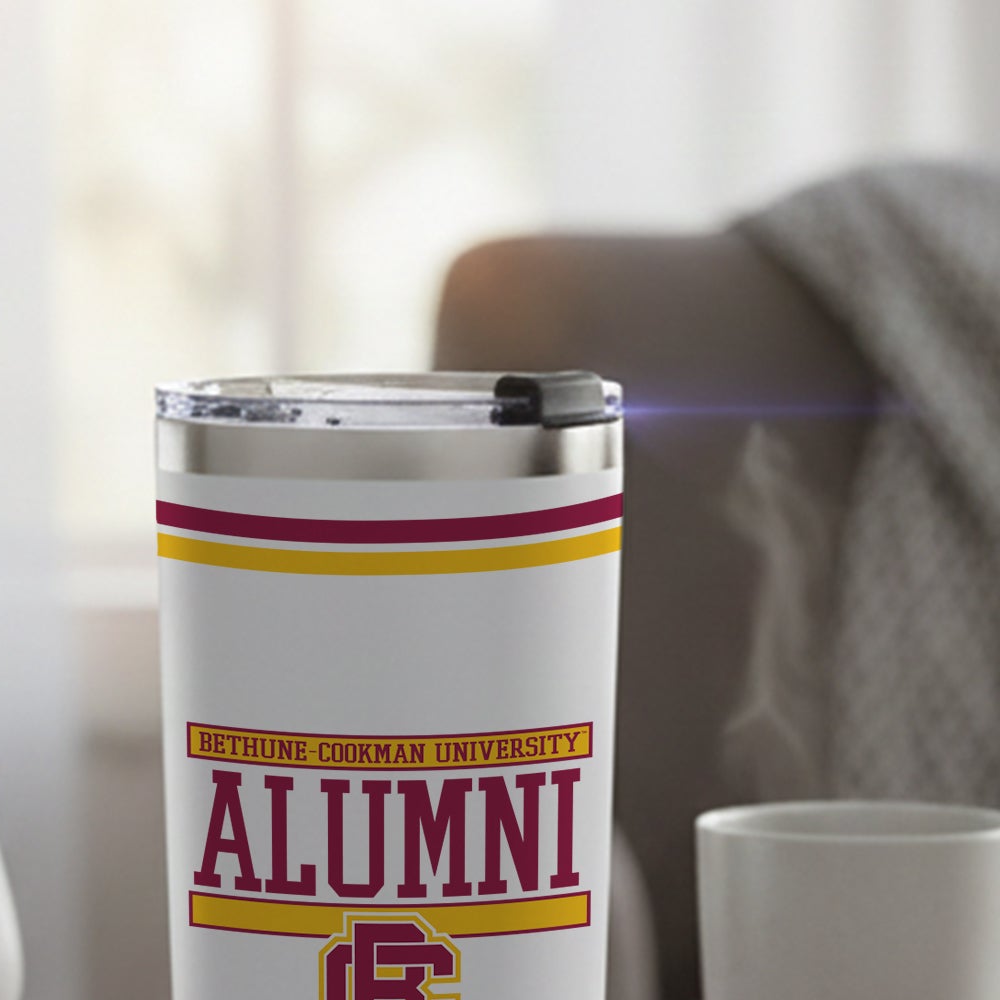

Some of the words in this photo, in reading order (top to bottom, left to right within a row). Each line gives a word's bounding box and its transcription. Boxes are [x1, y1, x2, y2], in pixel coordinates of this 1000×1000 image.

[199, 731, 425, 764] BETHUNE-COOKMAN
[435, 731, 580, 763] UNIVERSITY
[193, 768, 580, 898] ALUMNI
